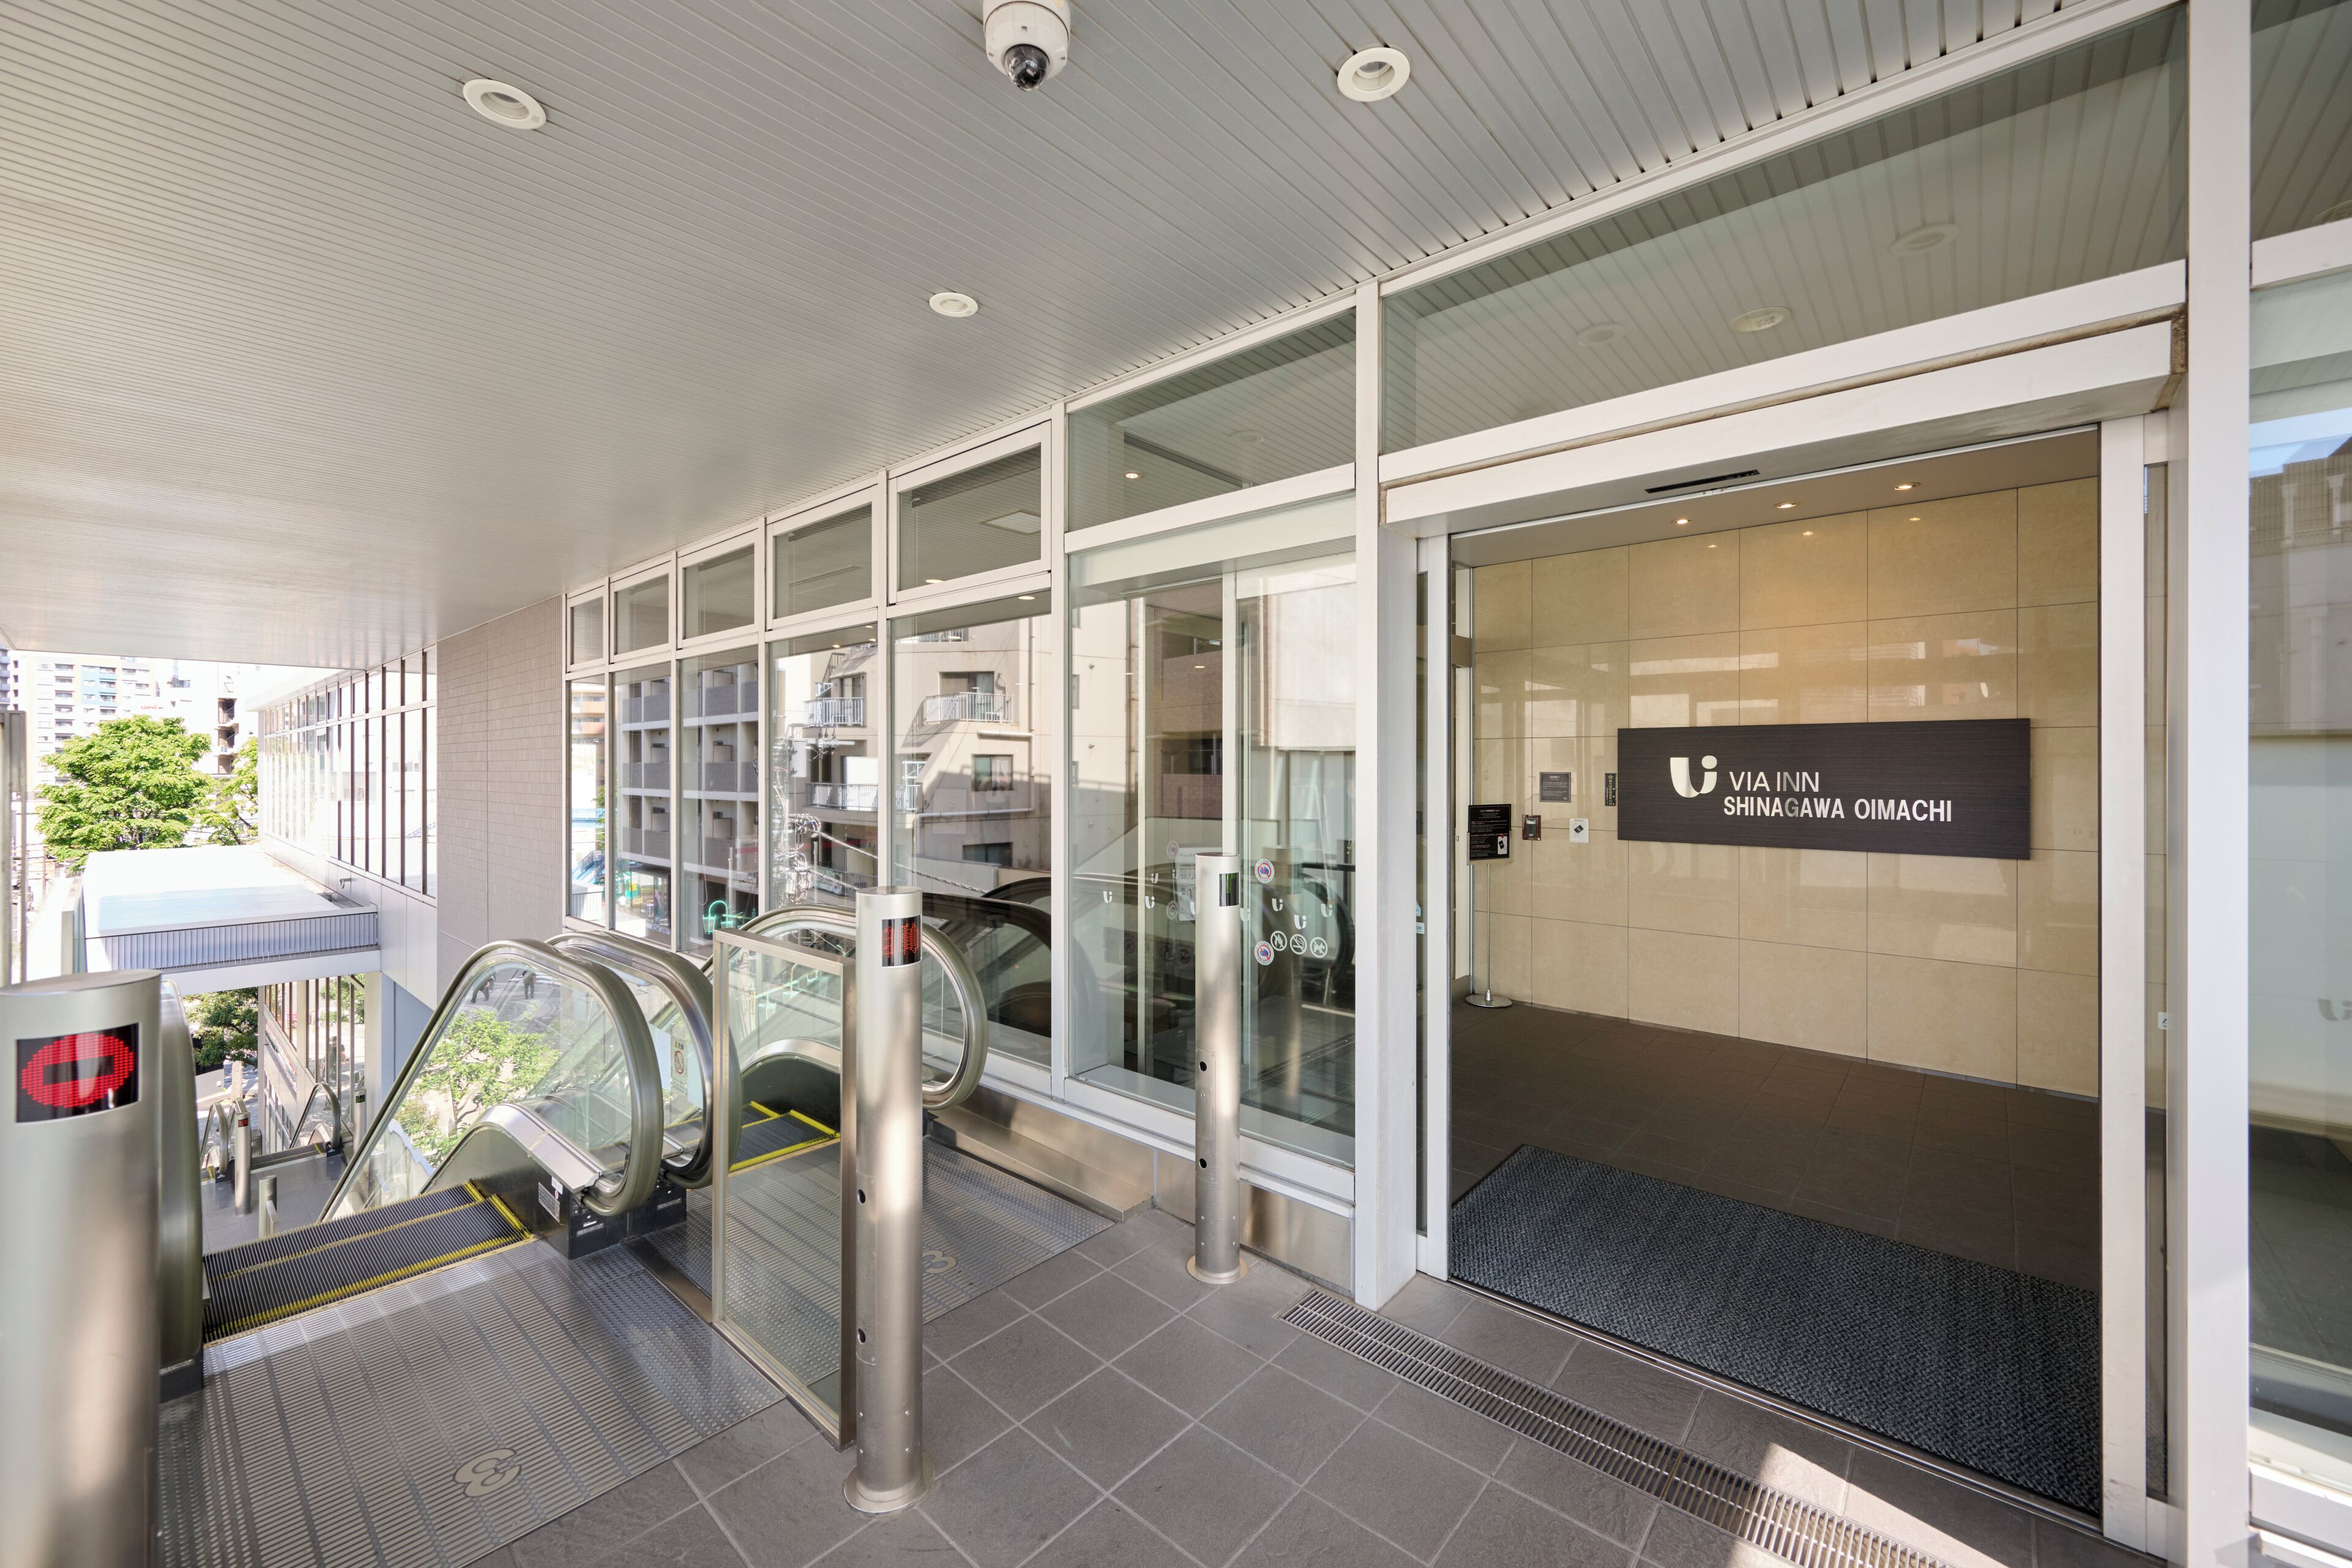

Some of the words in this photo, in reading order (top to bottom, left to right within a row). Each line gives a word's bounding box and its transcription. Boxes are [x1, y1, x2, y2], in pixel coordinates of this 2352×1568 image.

[1729, 771, 1771, 791] VIA
[1777, 771, 1819, 793] INN
[1724, 796, 1845, 819] SHINAGAWA
[1854, 798, 1952, 822] OIMACHI
